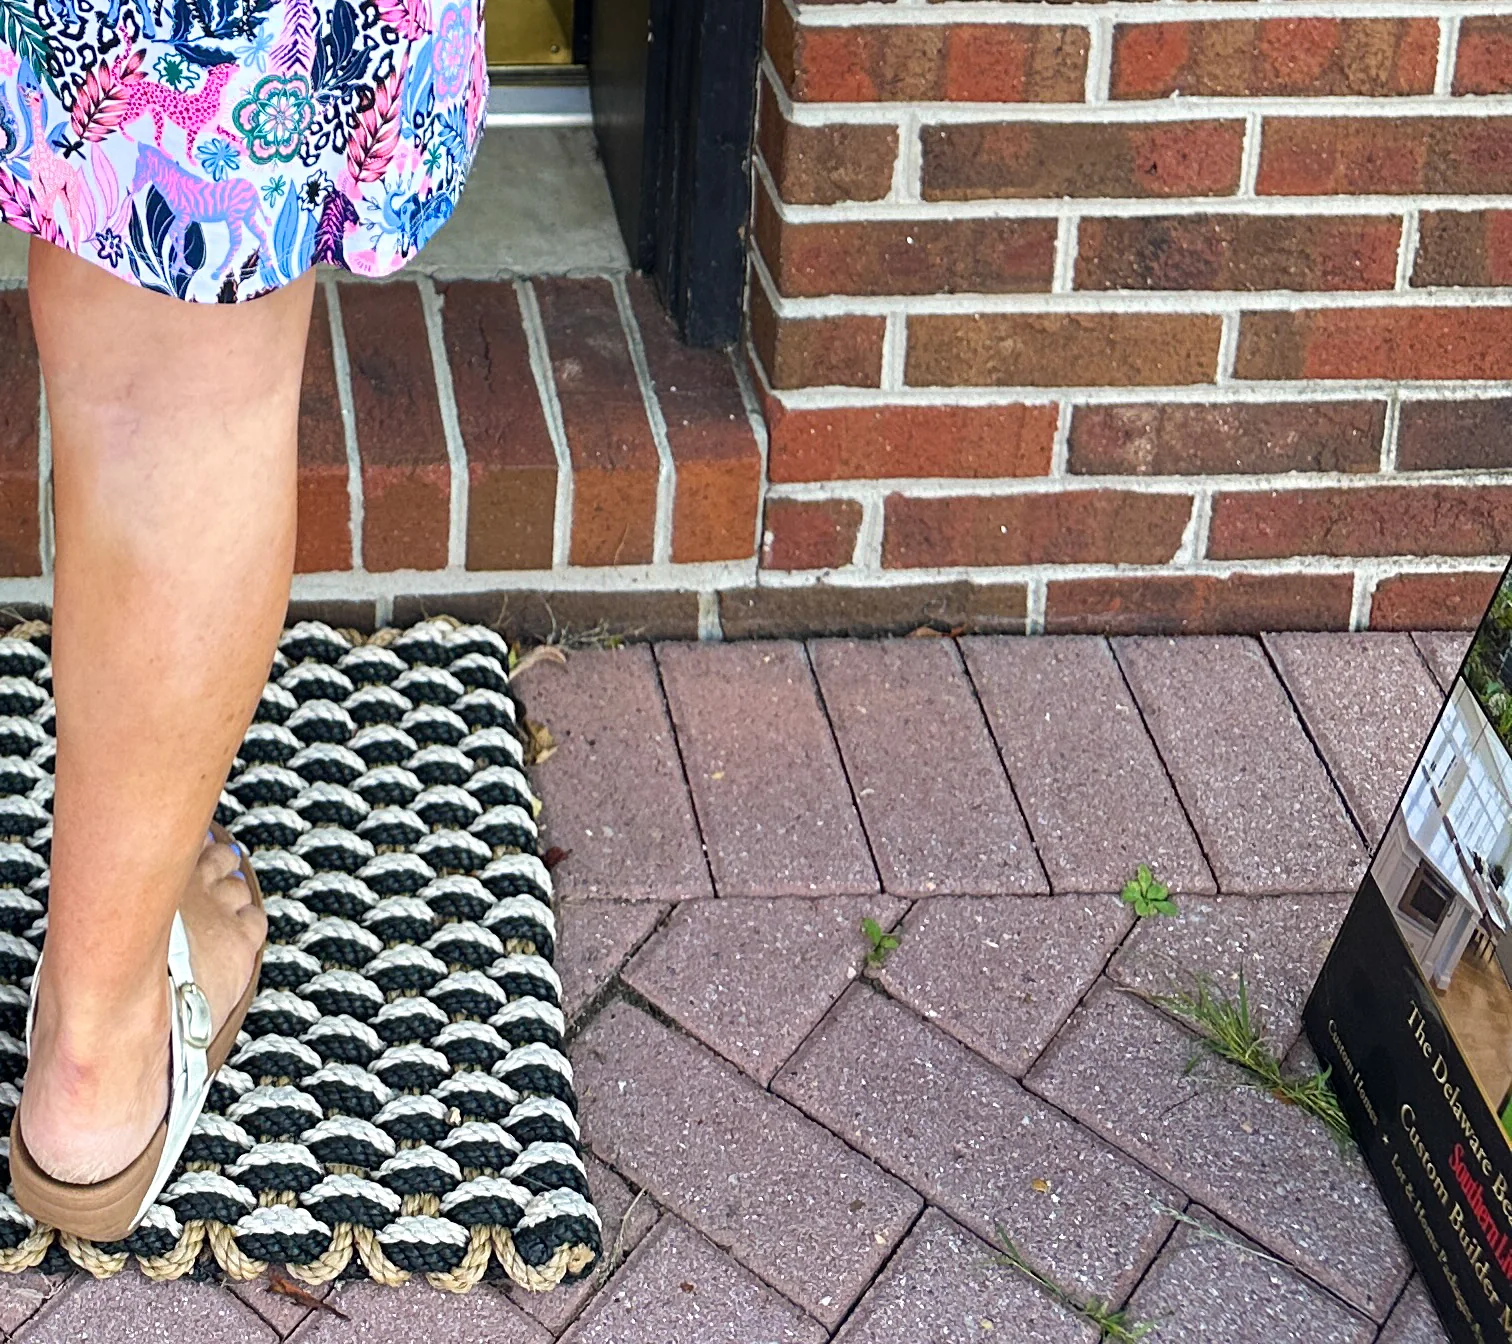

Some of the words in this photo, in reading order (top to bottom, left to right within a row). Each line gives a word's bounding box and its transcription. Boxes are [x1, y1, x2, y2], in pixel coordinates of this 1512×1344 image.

[1328, 1018, 1355, 1076] Custom
[1353, 1071, 1378, 1127] Homes
[1407, 999, 1432, 1059] The
[1432, 1053, 1492, 1177] Delaware
[1400, 1103, 1449, 1208] Custom
[1449, 1201, 1501, 1307] Builder
